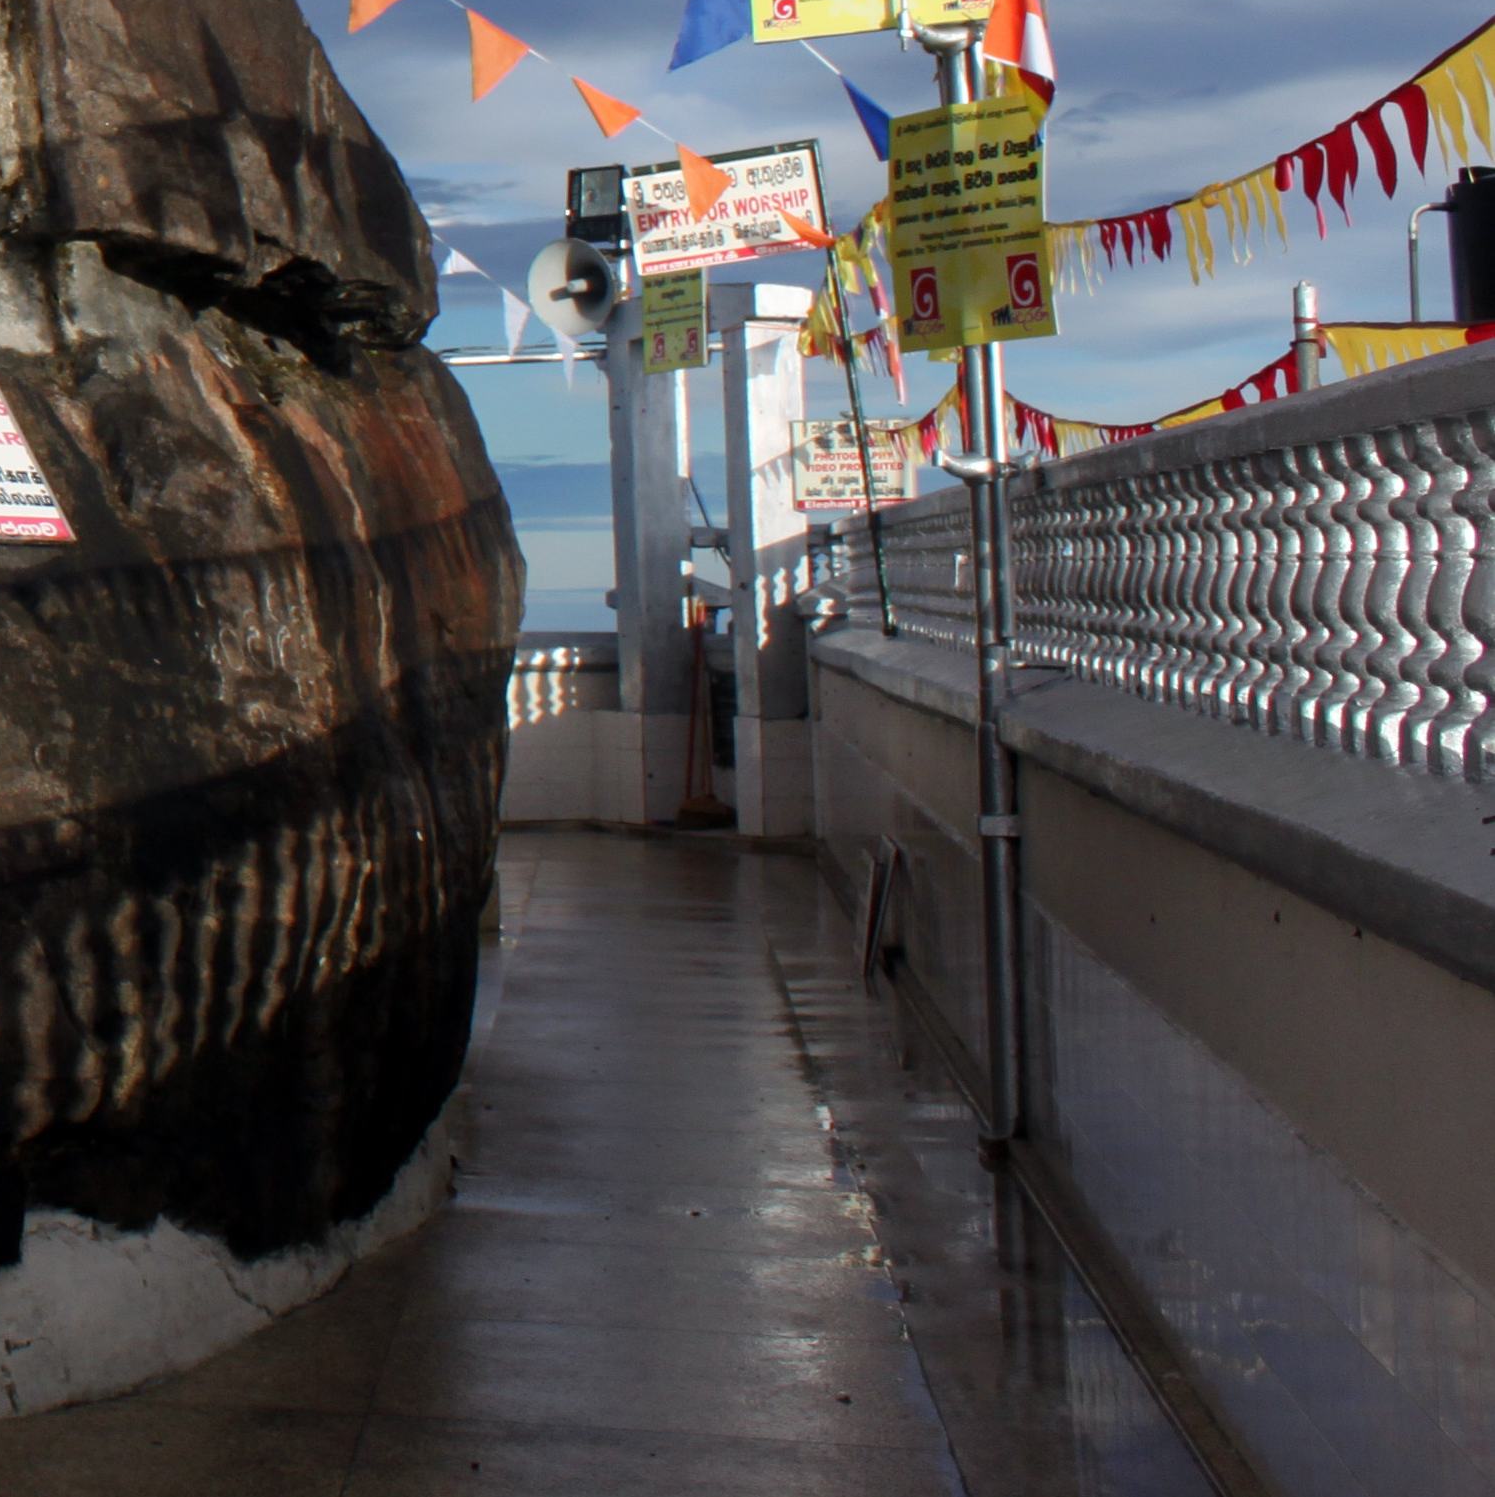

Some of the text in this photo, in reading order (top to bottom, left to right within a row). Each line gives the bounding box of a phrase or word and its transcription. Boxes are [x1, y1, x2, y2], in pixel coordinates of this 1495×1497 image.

[637, 189, 809, 232] ENTRY OR WORSHIP
[814, 452, 893, 461] PHOTOGPHY
[839, 462, 904, 471] PROBITED
